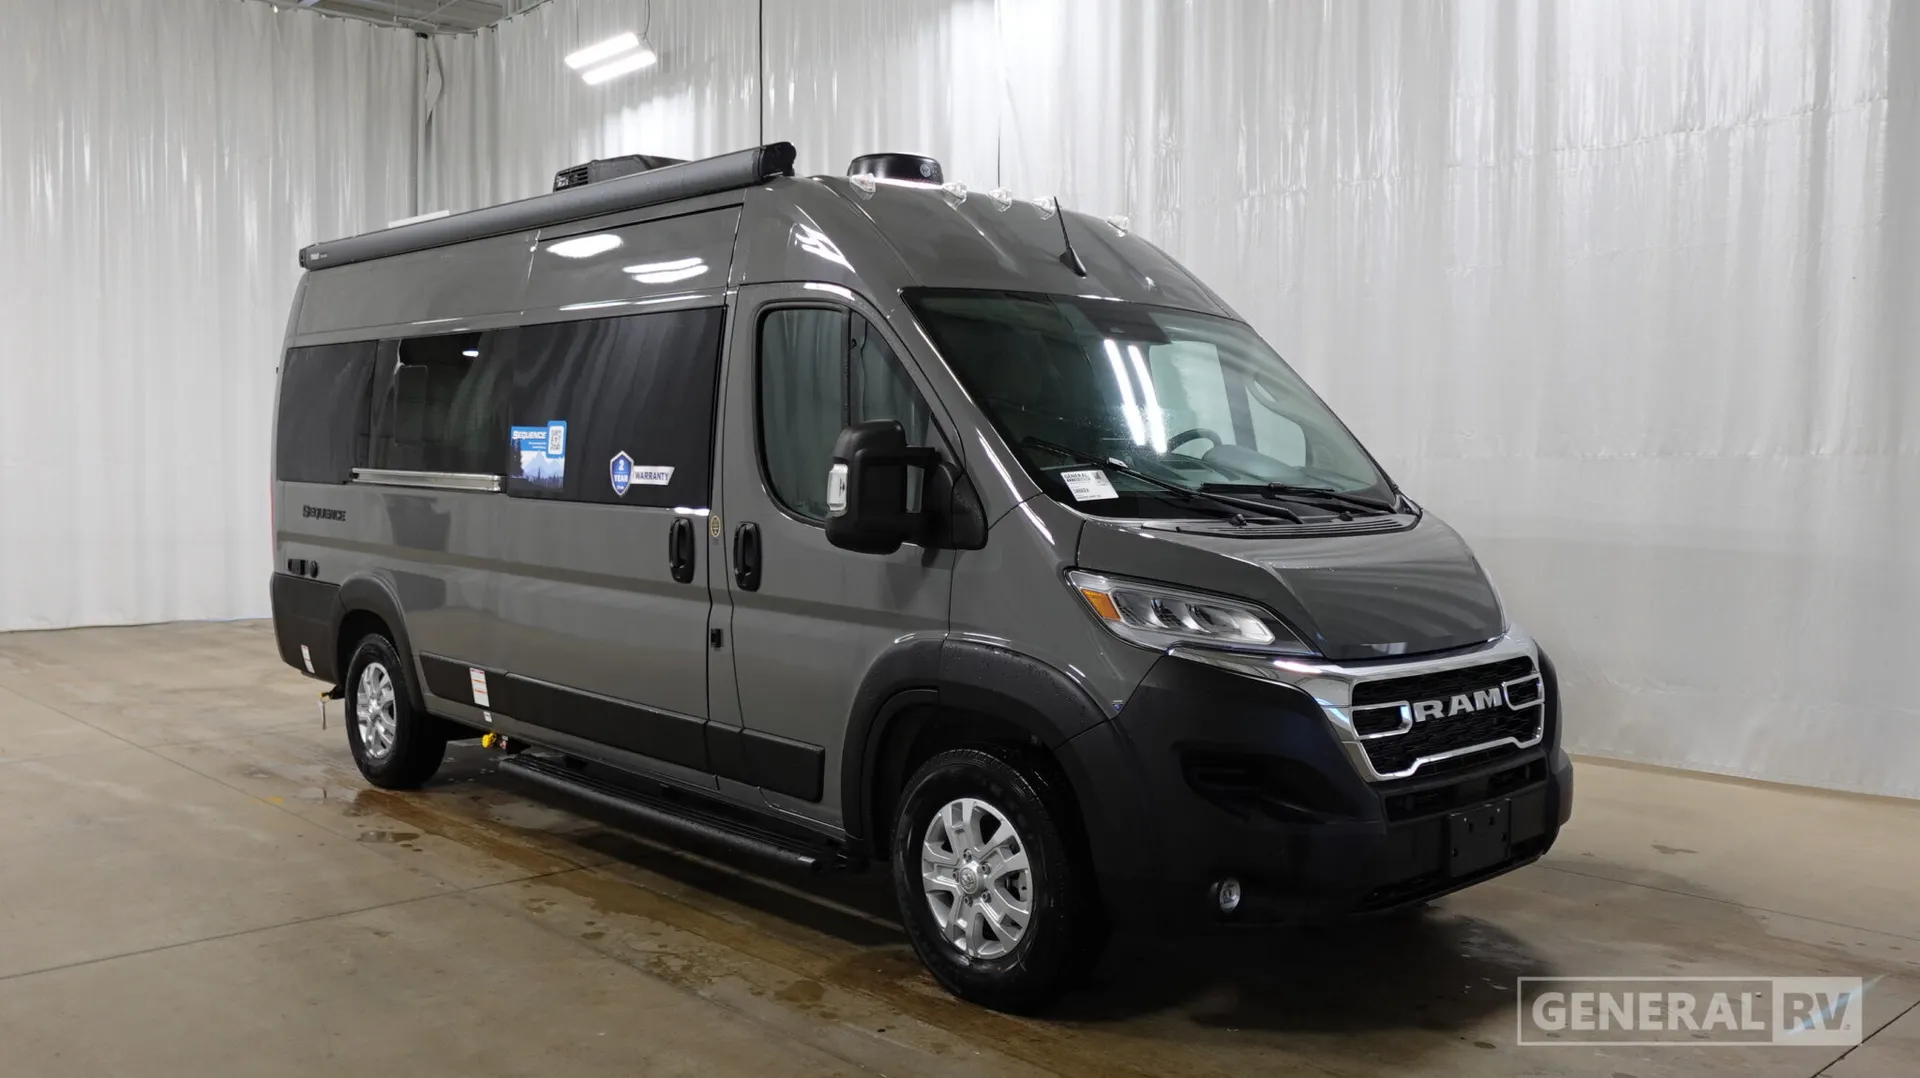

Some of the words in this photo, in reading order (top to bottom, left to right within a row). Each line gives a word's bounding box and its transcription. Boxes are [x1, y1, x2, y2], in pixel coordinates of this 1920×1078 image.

[512, 430, 547, 441] SEQUENCE
[618, 459, 625, 472] 2
[613, 473, 629, 483] YEAR
[634, 470, 669, 481] WARRANTY
[302, 504, 346, 521] SEQUENCE
[1412, 687, 1503, 723] RAM
